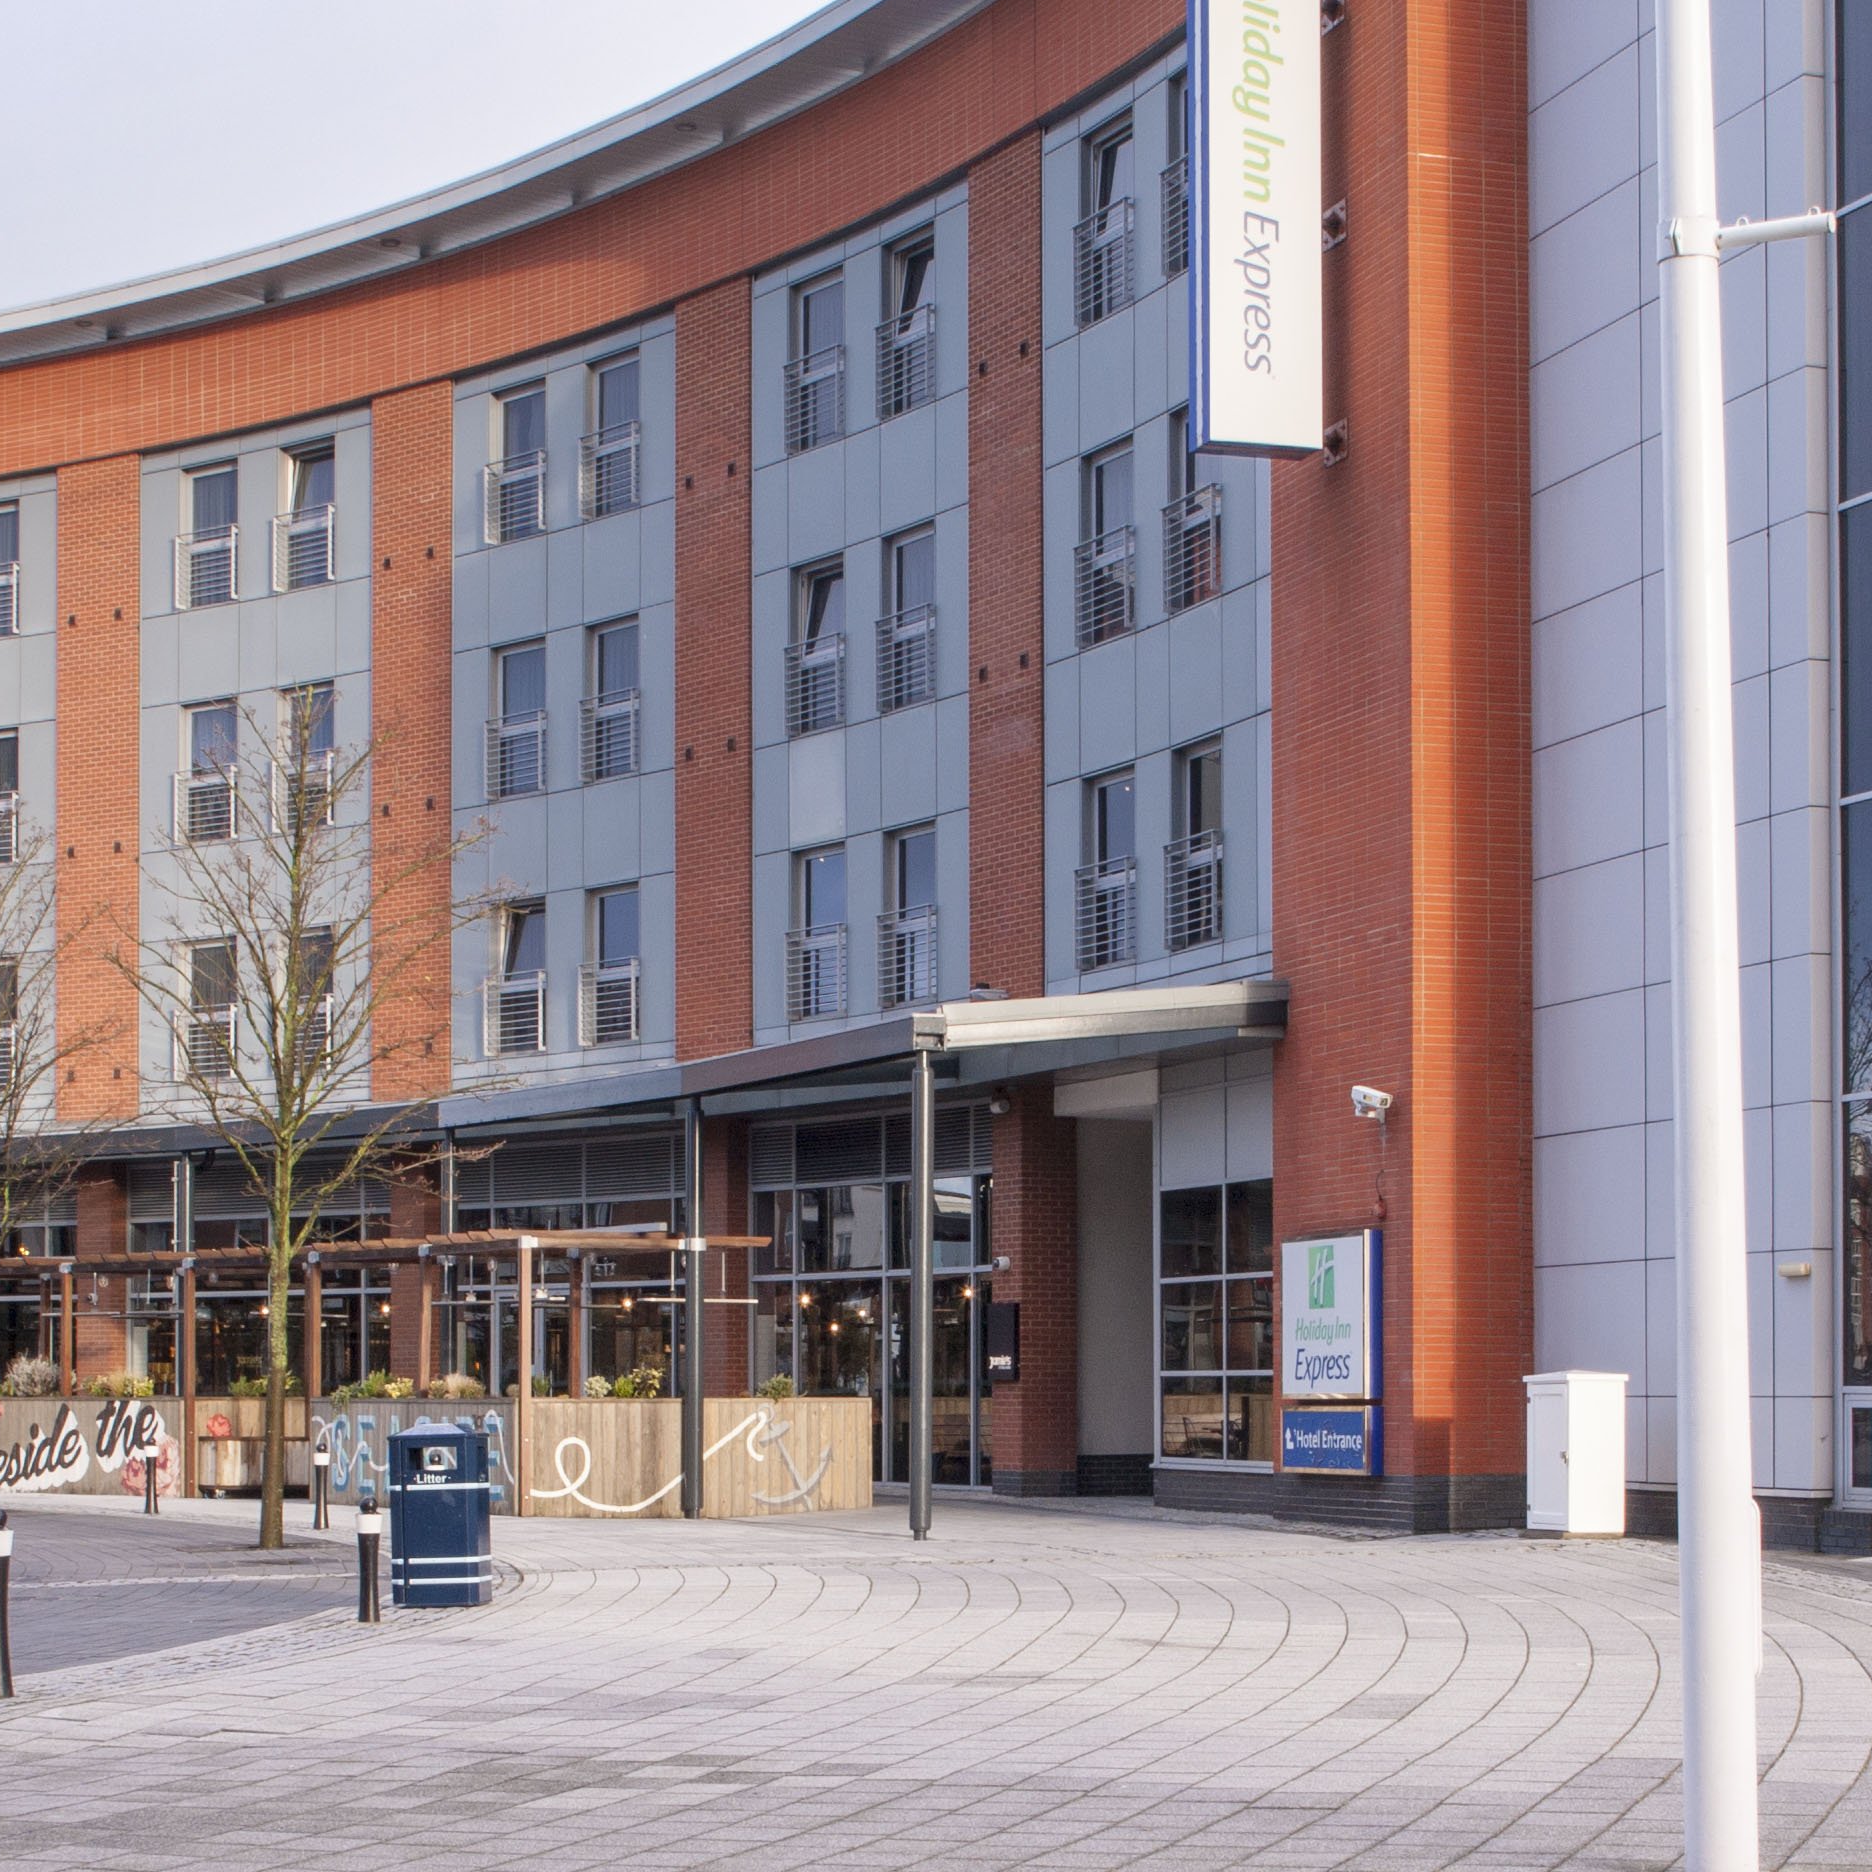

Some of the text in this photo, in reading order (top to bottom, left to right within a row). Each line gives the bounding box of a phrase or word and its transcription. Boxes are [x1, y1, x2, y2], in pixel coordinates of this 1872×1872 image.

[1242, 128, 1285, 203] Inn
[1233, 210, 1279, 375] Express
[1295, 1315, 1352, 1346] Holiday Inn
[1295, 1348, 1352, 1389] Express
[95, 1400, 158, 1458] the
[1296, 1429, 1363, 1451] Hotel Entrance
